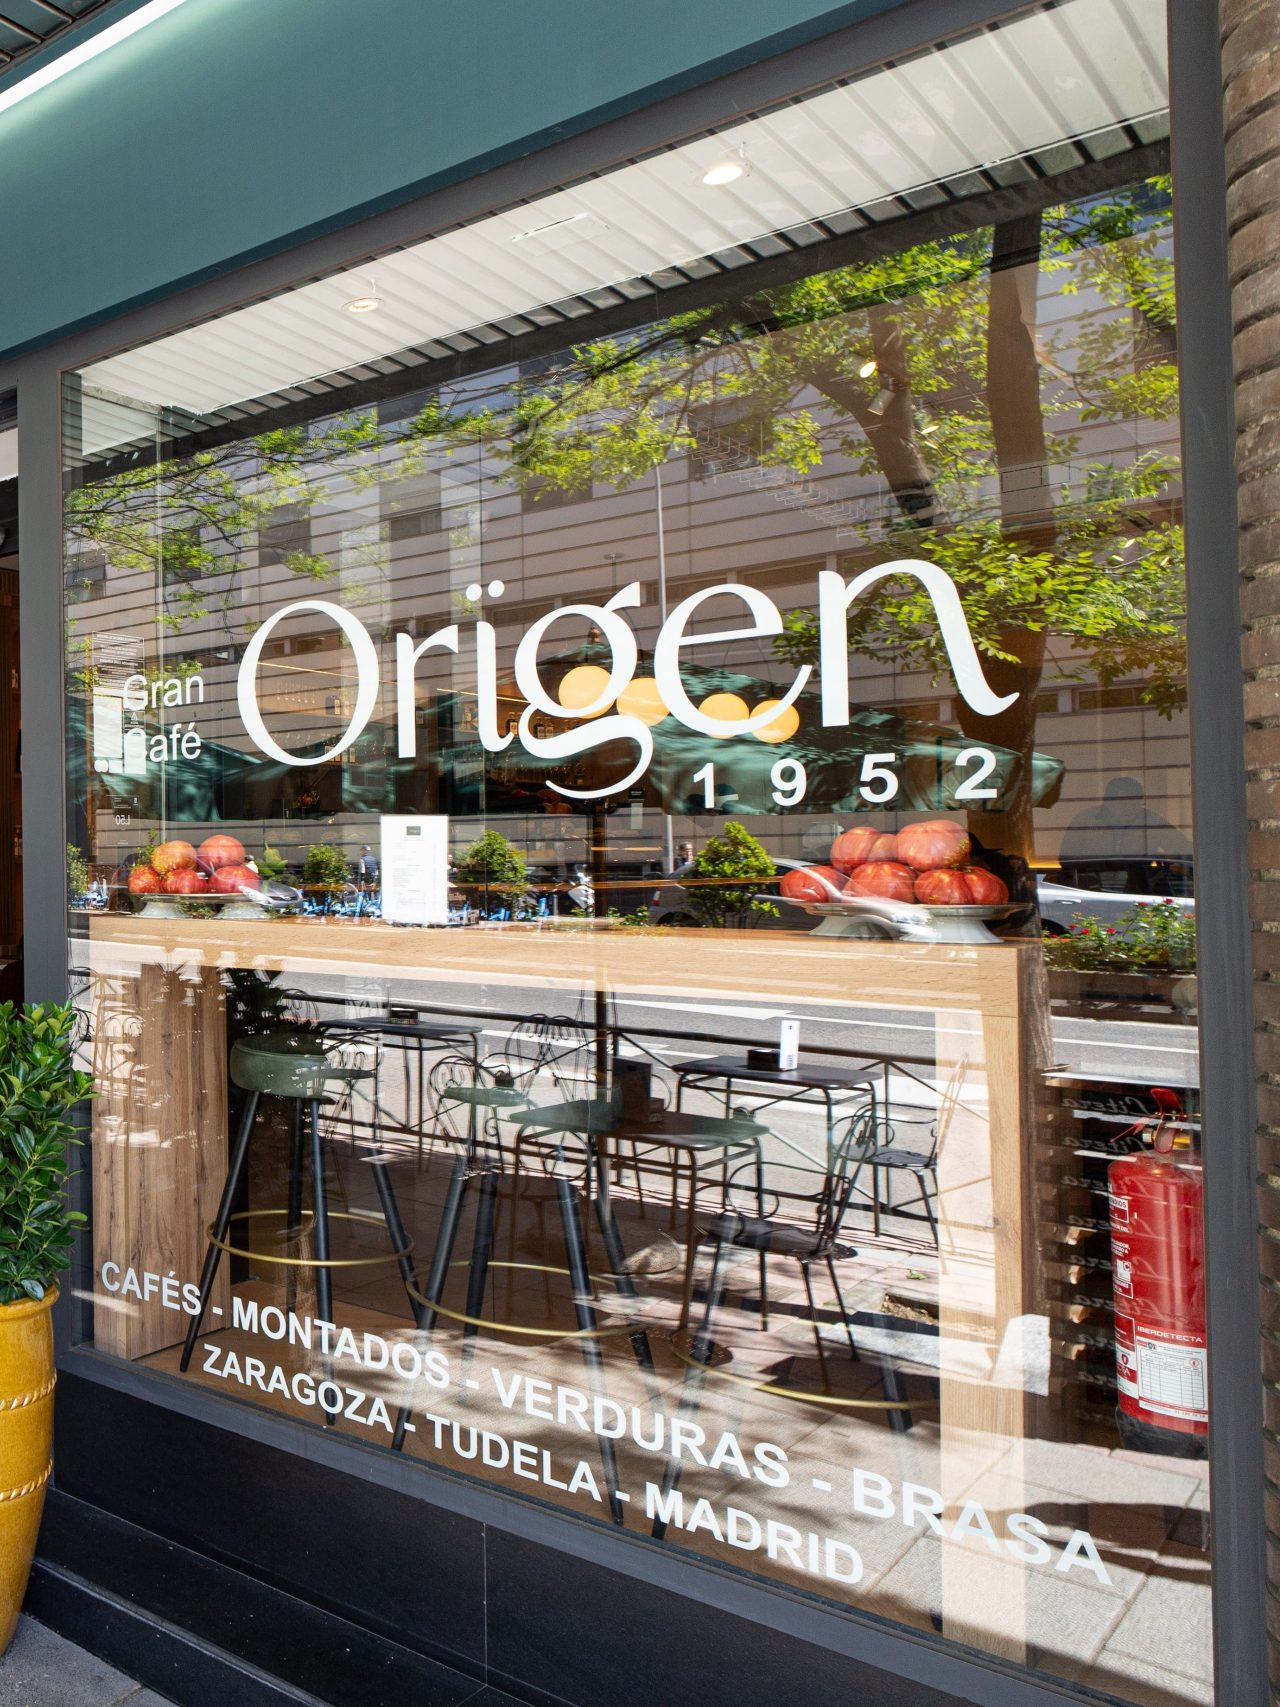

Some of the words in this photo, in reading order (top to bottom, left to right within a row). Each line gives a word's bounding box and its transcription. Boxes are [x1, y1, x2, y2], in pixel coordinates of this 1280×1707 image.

[123, 674, 204, 711] Gran
[691, 747, 998, 809] 1952
[1137, 1325, 1203, 1344] IBERDETECTA
[101, 1261, 203, 1315] CAFÉS
[232, 1297, 451, 1389] MONTADOS
[490, 1368, 790, 1488] VERDURAS
[851, 1470, 1112, 1585] BRASA
[202, 1344, 394, 1433] ZARAGOZA
[426, 1414, 603, 1502] TUDELA
[646, 1483, 865, 1585] MADRID
